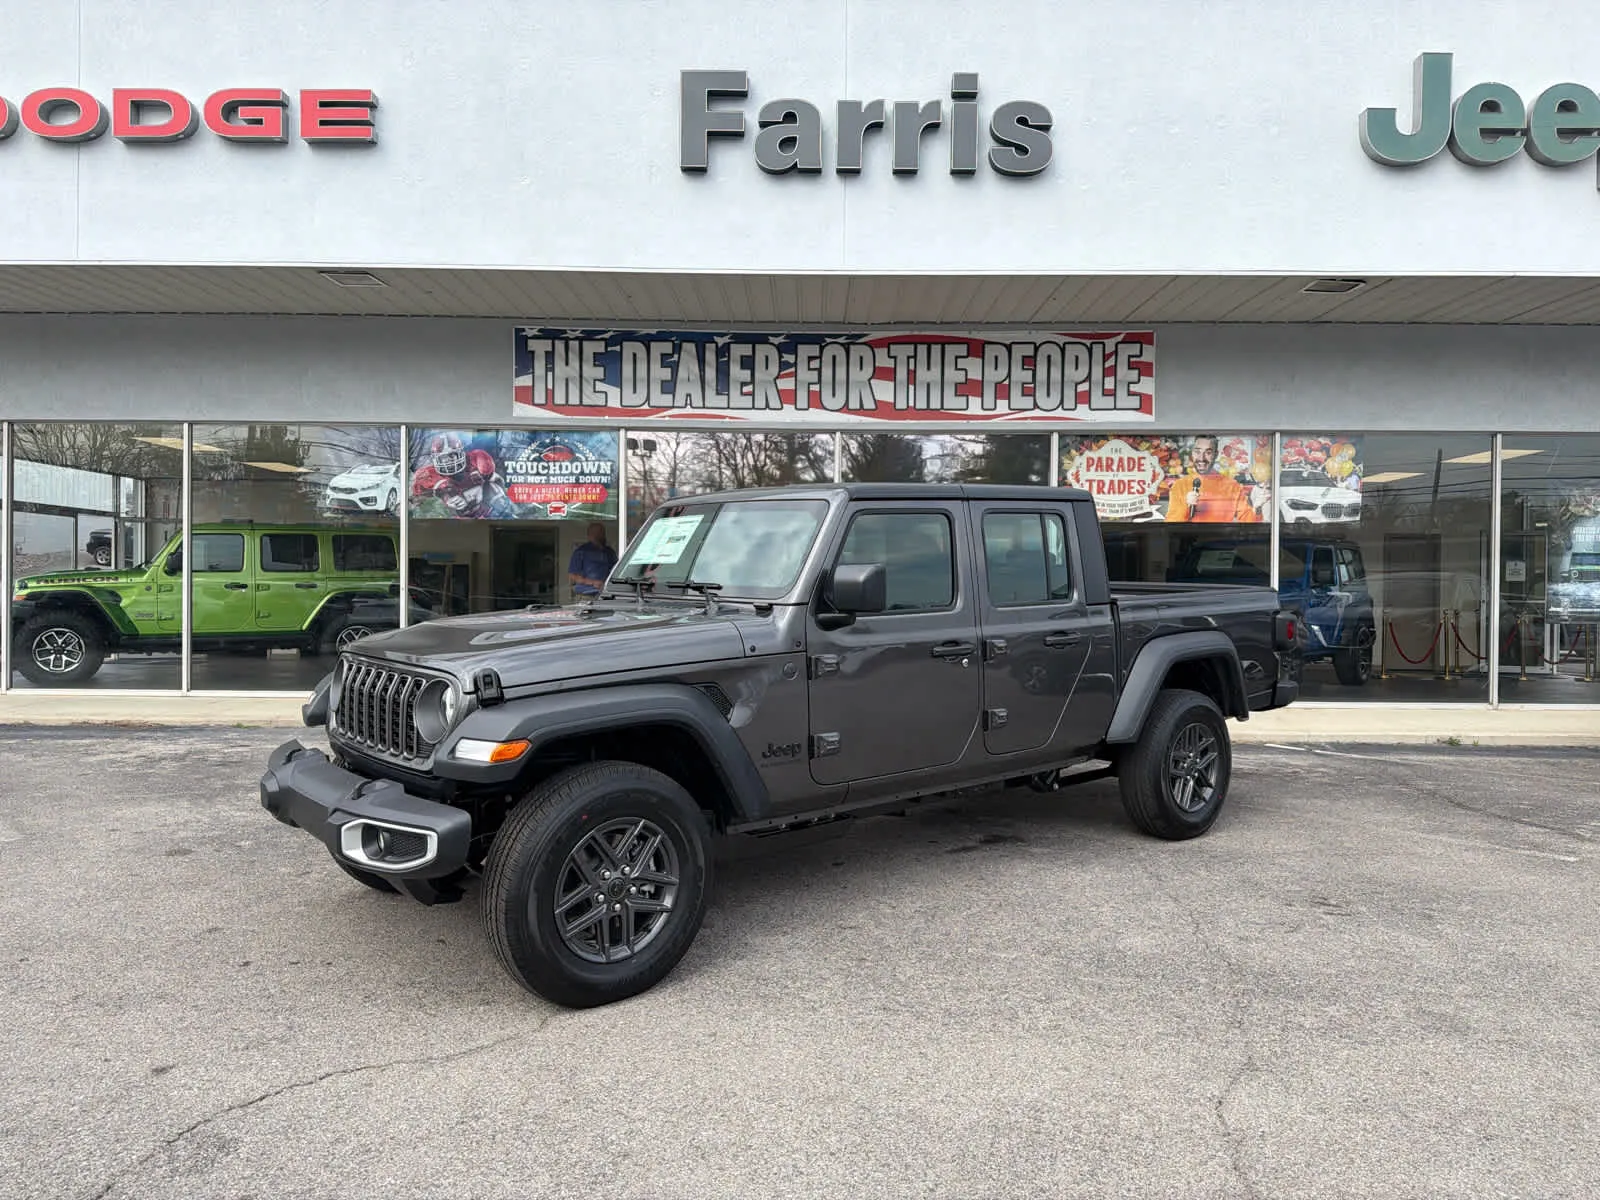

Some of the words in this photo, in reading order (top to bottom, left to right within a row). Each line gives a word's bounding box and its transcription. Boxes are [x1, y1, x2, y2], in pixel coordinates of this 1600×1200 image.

[0, 87, 379, 145] ODGE
[679, 69, 1054, 176] Farris
[1358, 51, 1600, 192] Jee
[527, 337, 608, 408] THE
[618, 340, 784, 411] DEALER
[795, 342, 877, 411] FOR
[888, 341, 969, 411] THE
[981, 340, 1144, 412] PEOPLE
[504, 461, 613, 474] TOUCHDOWN
[1085, 456, 1147, 473] PARADE
[506, 475, 526, 484] FOR
[527, 475, 548, 484] NOT
[549, 475, 576, 484] MUCH
[579, 475, 612, 484] DOWN!
[1085, 479, 1147, 495] TRADES
[36, 576, 120, 585] RUBICON
[762, 743, 802, 759] Jeep
